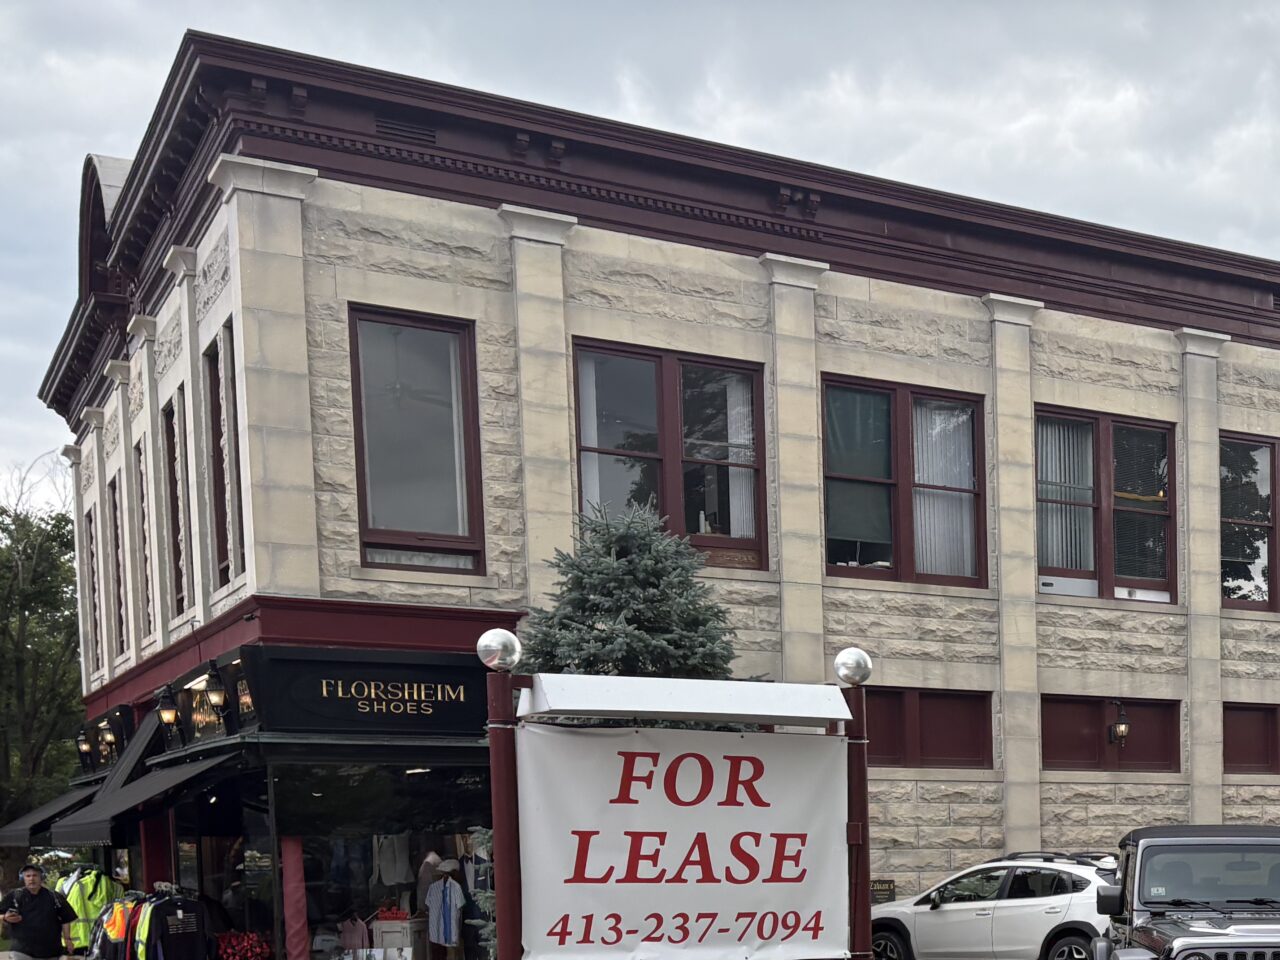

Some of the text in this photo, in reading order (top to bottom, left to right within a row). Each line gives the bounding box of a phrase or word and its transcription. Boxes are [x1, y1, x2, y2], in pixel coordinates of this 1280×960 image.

[320, 679, 465, 702] FLORSHEIM
[358, 701, 433, 715] SHOES
[609, 751, 771, 808] FOR
[563, 830, 808, 885] LEASE
[546, 910, 824, 946] 413-237-7094
